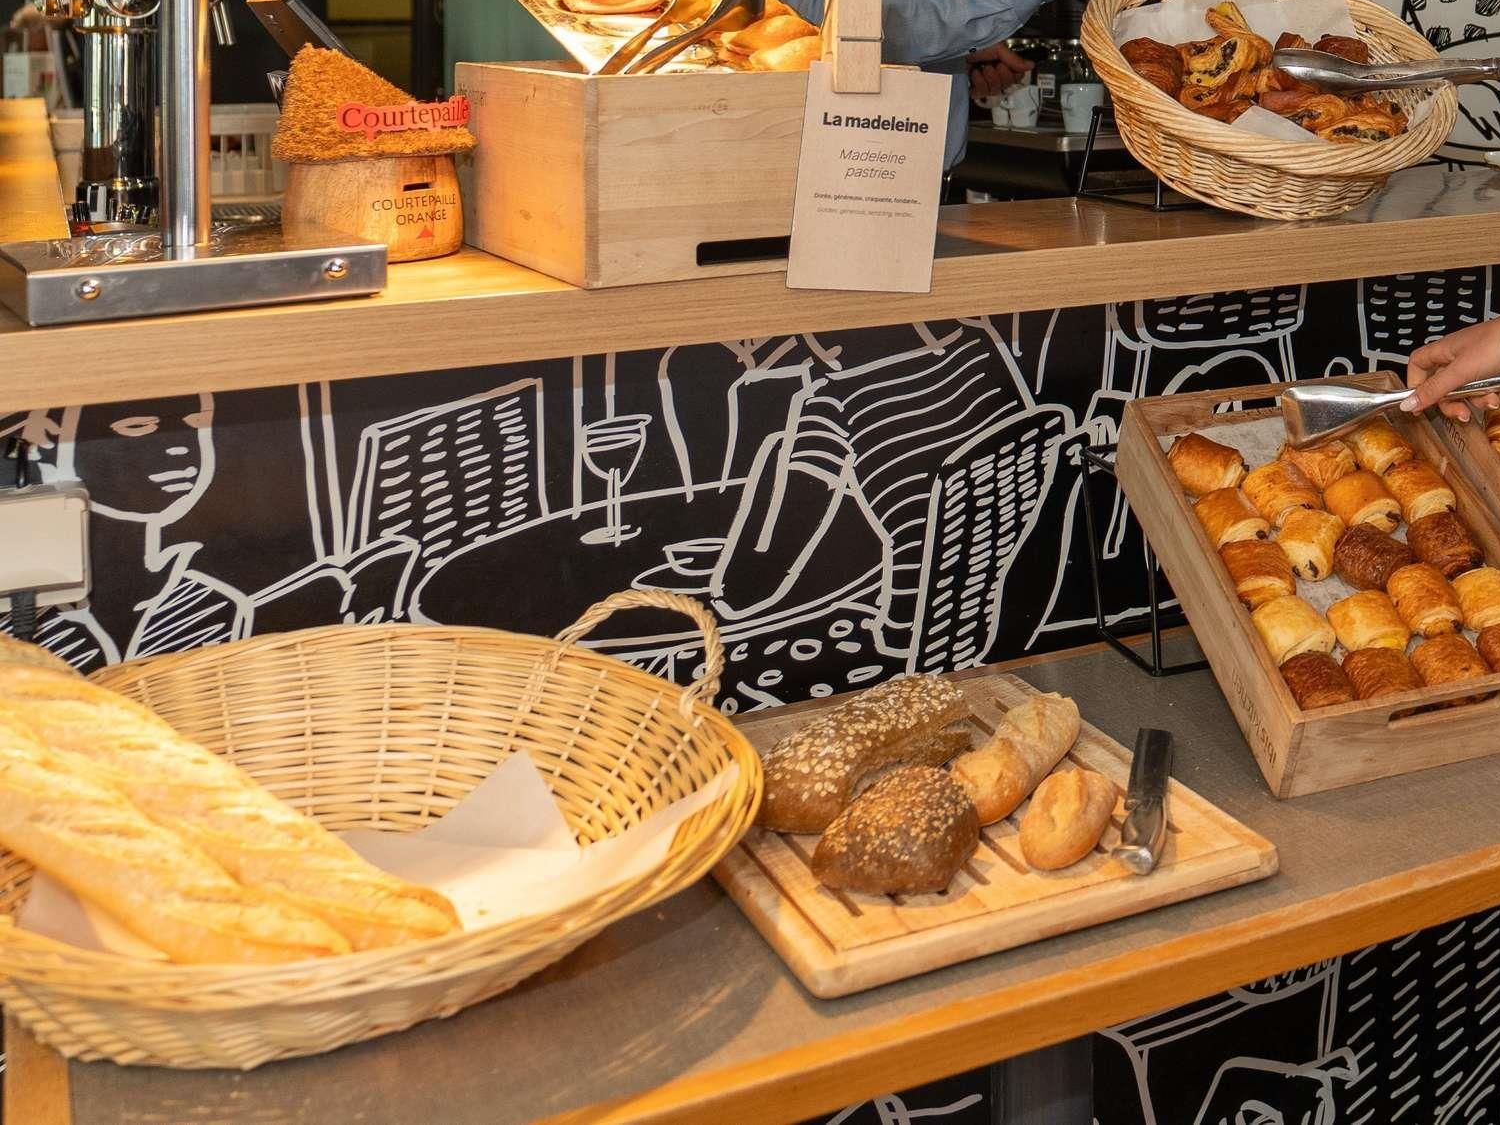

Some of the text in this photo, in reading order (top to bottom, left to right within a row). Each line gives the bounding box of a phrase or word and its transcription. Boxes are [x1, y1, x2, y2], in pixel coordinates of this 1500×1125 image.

[341, 99, 469, 128] Courtepaille
[823, 112, 929, 134] La madeleine
[839, 148, 907, 165] Madeleine
[844, 166, 897, 180] pastries
[372, 194, 456, 212] COURTEPAILLE
[395, 209, 447, 226] ORANGE
